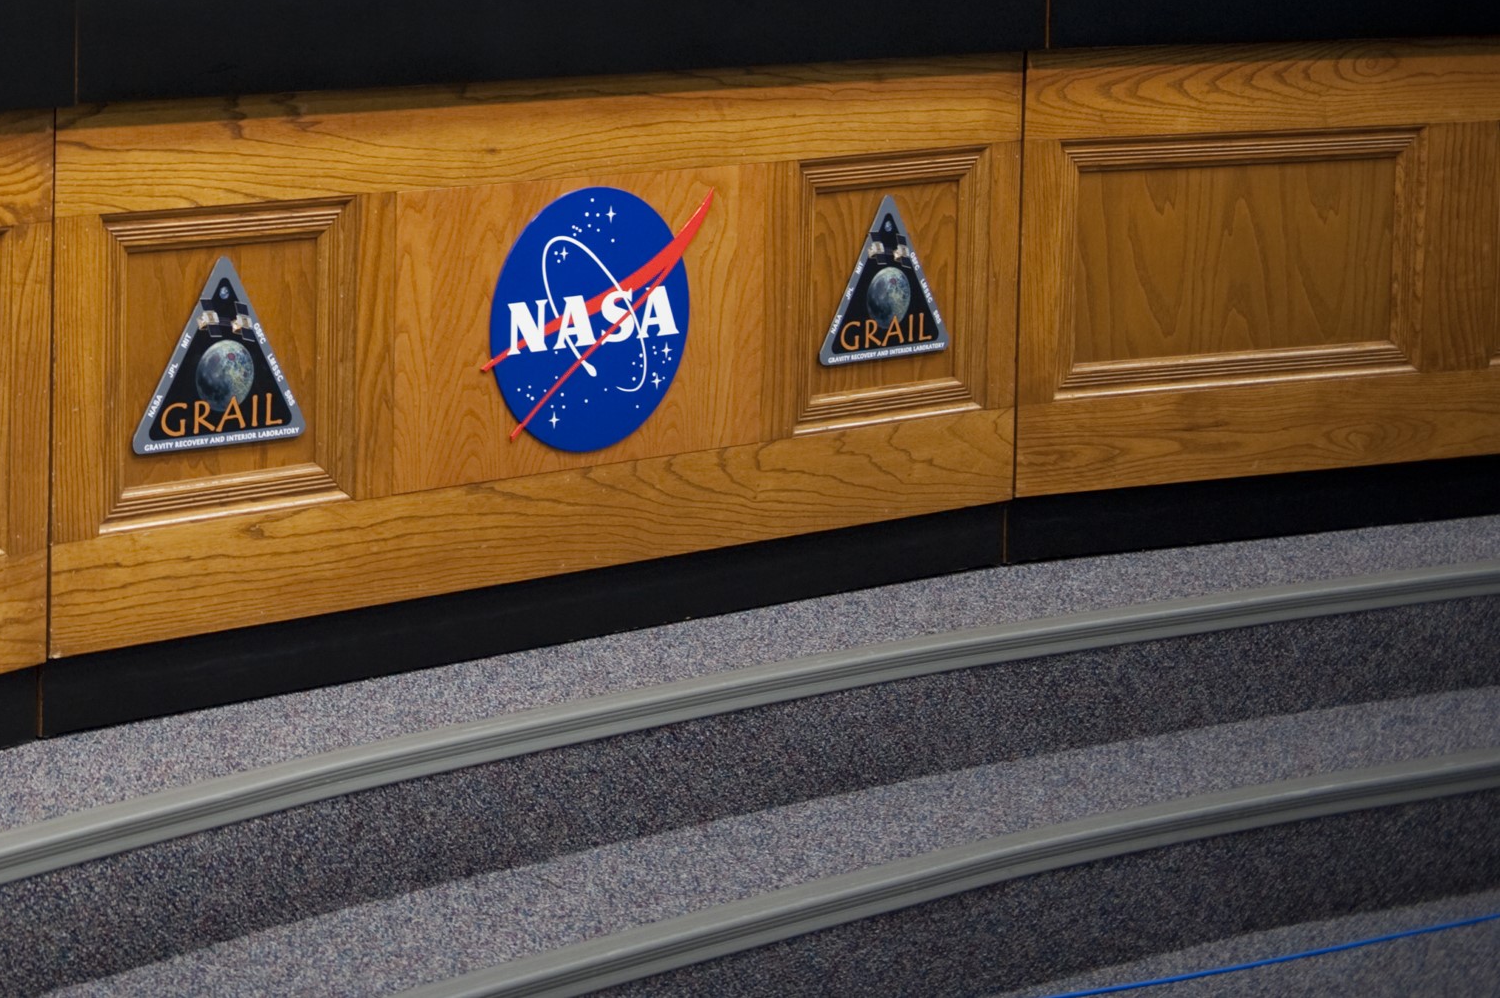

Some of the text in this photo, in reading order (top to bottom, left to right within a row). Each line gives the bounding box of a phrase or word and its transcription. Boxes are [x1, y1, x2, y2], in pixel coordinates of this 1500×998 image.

[507, 285, 680, 356] NASA
[831, 314, 843, 334] NASA
[840, 313, 932, 351] GRAIL
[181, 333, 191, 349] MIT
[828, 355, 850, 364] GRAVITY
[851, 351, 876, 360] RECOVERY
[890, 346, 912, 355] INTERIOR
[913, 342, 945, 352] LABORATORY
[168, 363, 179, 378] JPL
[267, 353, 283, 382] LMSSC
[148, 394, 163, 418] NASA
[284, 389, 295, 406] SRS
[160, 393, 283, 437] GRAIL
[144, 427, 300, 452] GRAVITY RECOVERY AND INTERIOR LABORATORY
